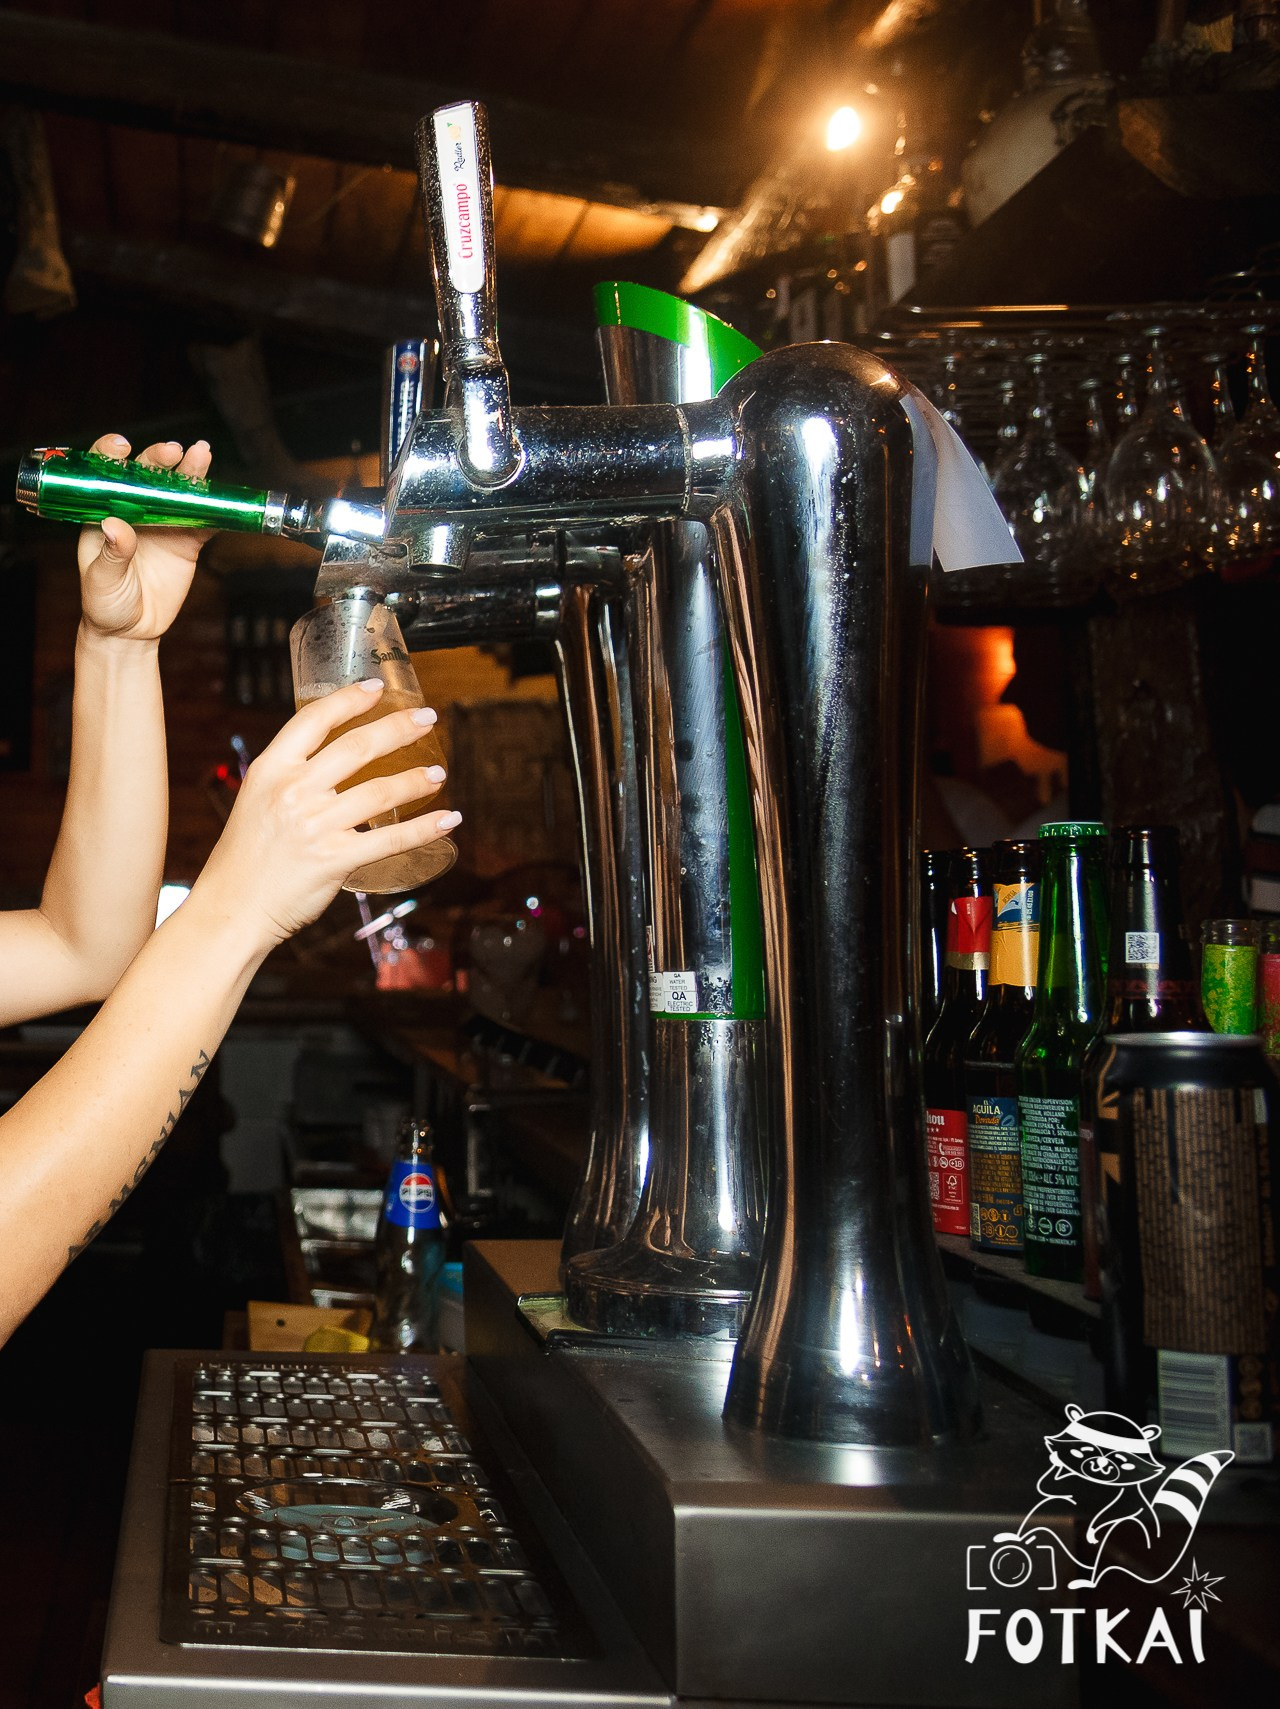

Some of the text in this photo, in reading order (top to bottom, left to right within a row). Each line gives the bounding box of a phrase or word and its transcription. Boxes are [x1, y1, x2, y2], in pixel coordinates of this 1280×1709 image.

[453, 142, 466, 172] Radler
[457, 183, 473, 259] Cruzcampo
[671, 991, 687, 1001] QA
[926, 1110, 945, 1126] hou
